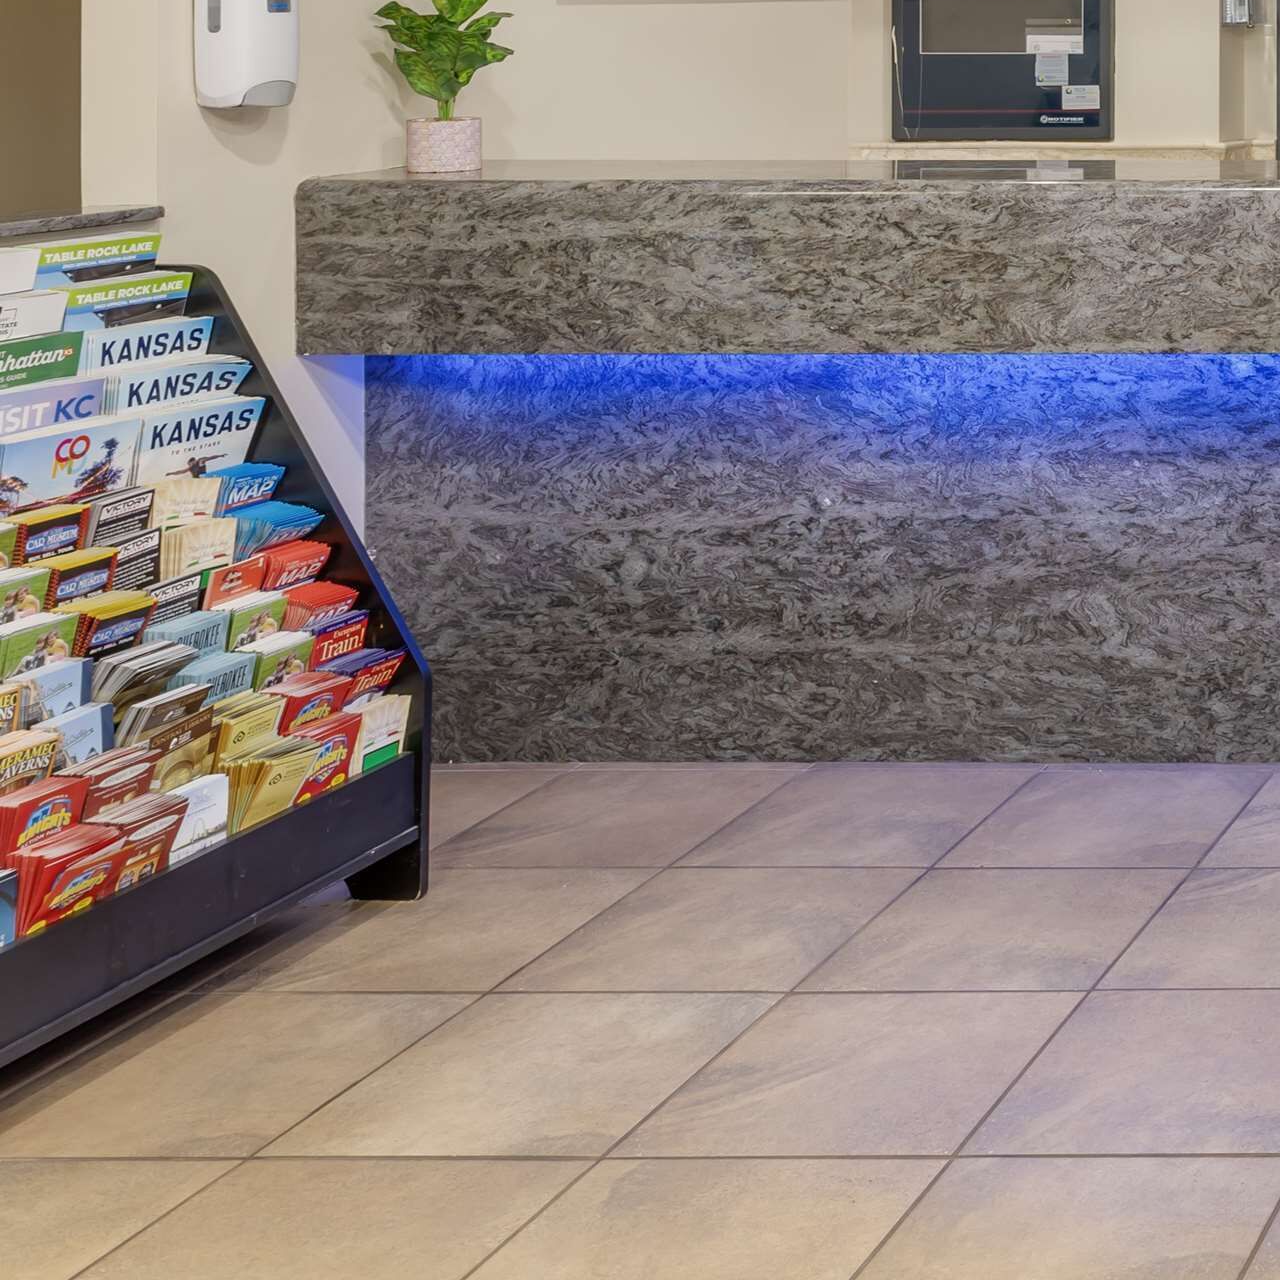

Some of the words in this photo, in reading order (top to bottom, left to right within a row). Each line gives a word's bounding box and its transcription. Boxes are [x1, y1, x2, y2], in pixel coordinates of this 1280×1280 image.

[44, 250, 86, 264] TABLE
[87, 245, 121, 258] ROCK
[121, 241, 153, 254] LAKE
[76, 290, 116, 305] TABLE
[117, 285, 151, 299] ROCK
[151, 281, 184, 293] LAKE
[100, 328, 204, 367] KANSAS
[128, 371, 238, 407] KANSAS
[0, 401, 50, 436] ISIT
[53, 394, 95, 422] KC
[150, 408, 255, 450] KANSAS
[228, 480, 275, 504] MAP
[105, 496, 149, 515] VICTORY
[276, 561, 322, 586] MAP
[152, 577, 198, 599] VICTORY
[177, 623, 221, 650] EROKEE
[320, 627, 366, 661] Train!
[0, 754, 51, 780] AVERNS
